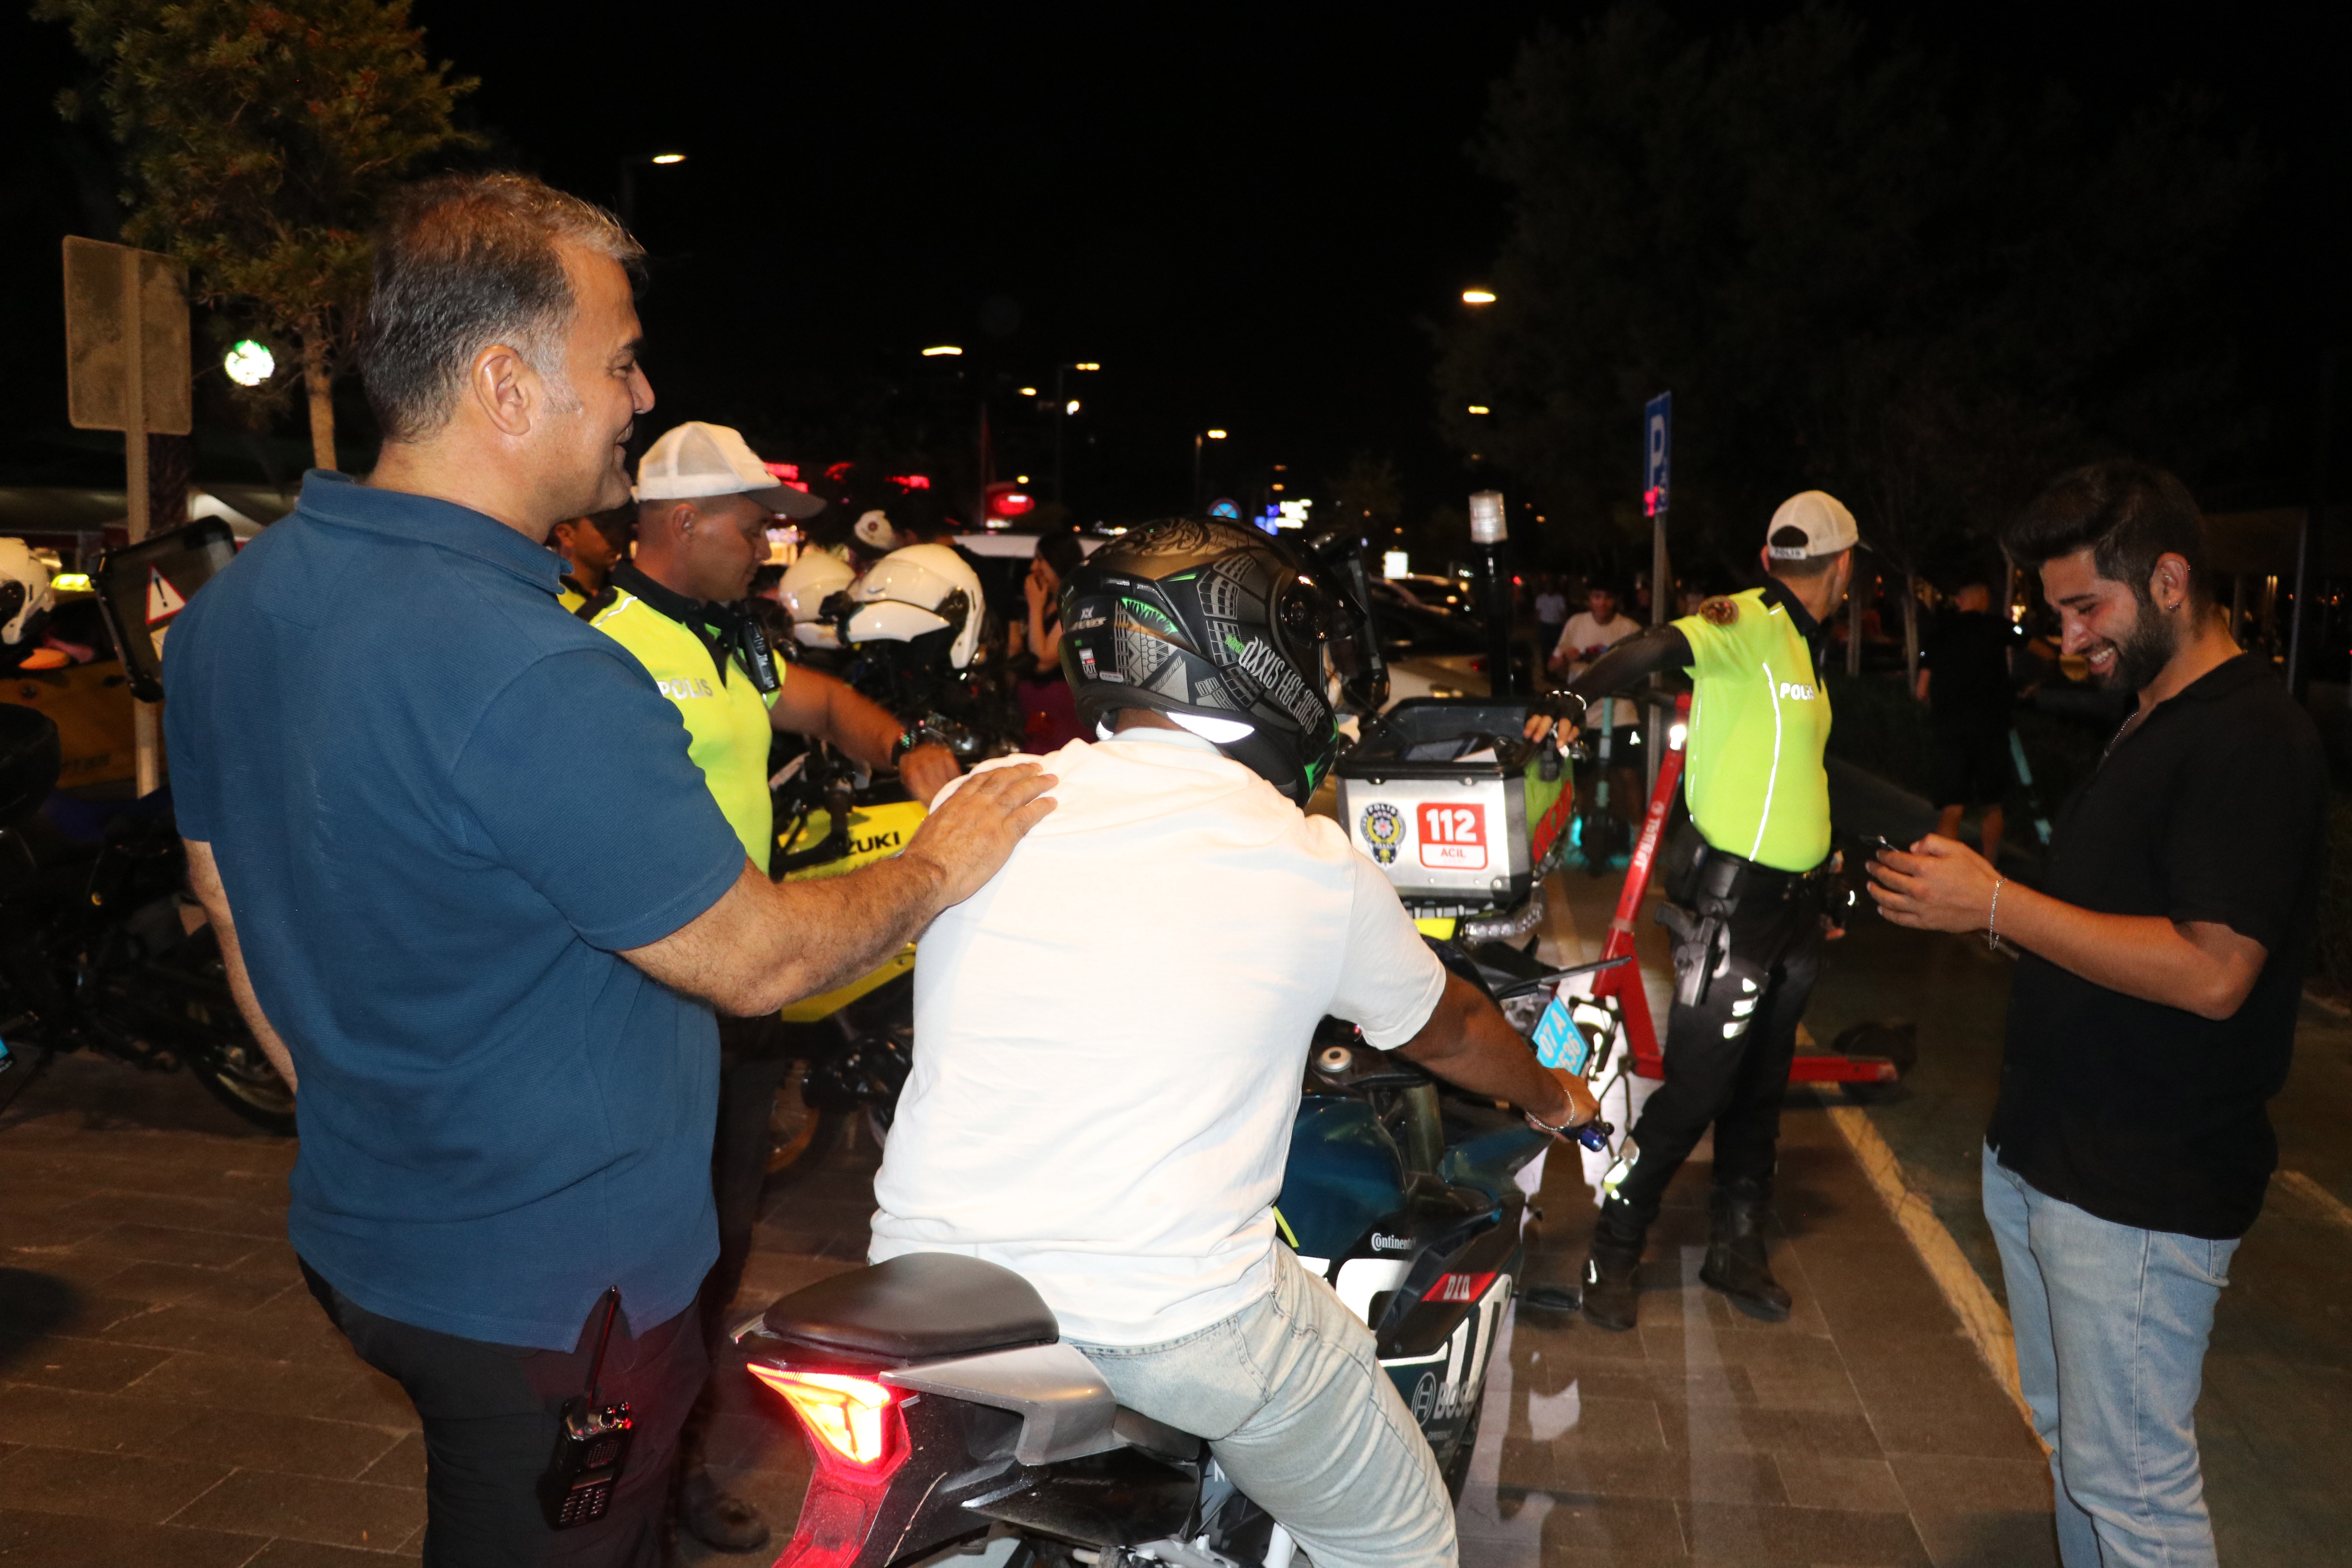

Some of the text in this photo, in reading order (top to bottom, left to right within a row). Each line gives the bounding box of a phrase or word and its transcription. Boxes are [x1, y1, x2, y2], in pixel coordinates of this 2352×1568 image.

[1650, 414, 1665, 491] P
[1426, 808, 1477, 842] 112
[848, 831, 900, 855] ZUKI
[1539, 1022, 1558, 1059] 07
